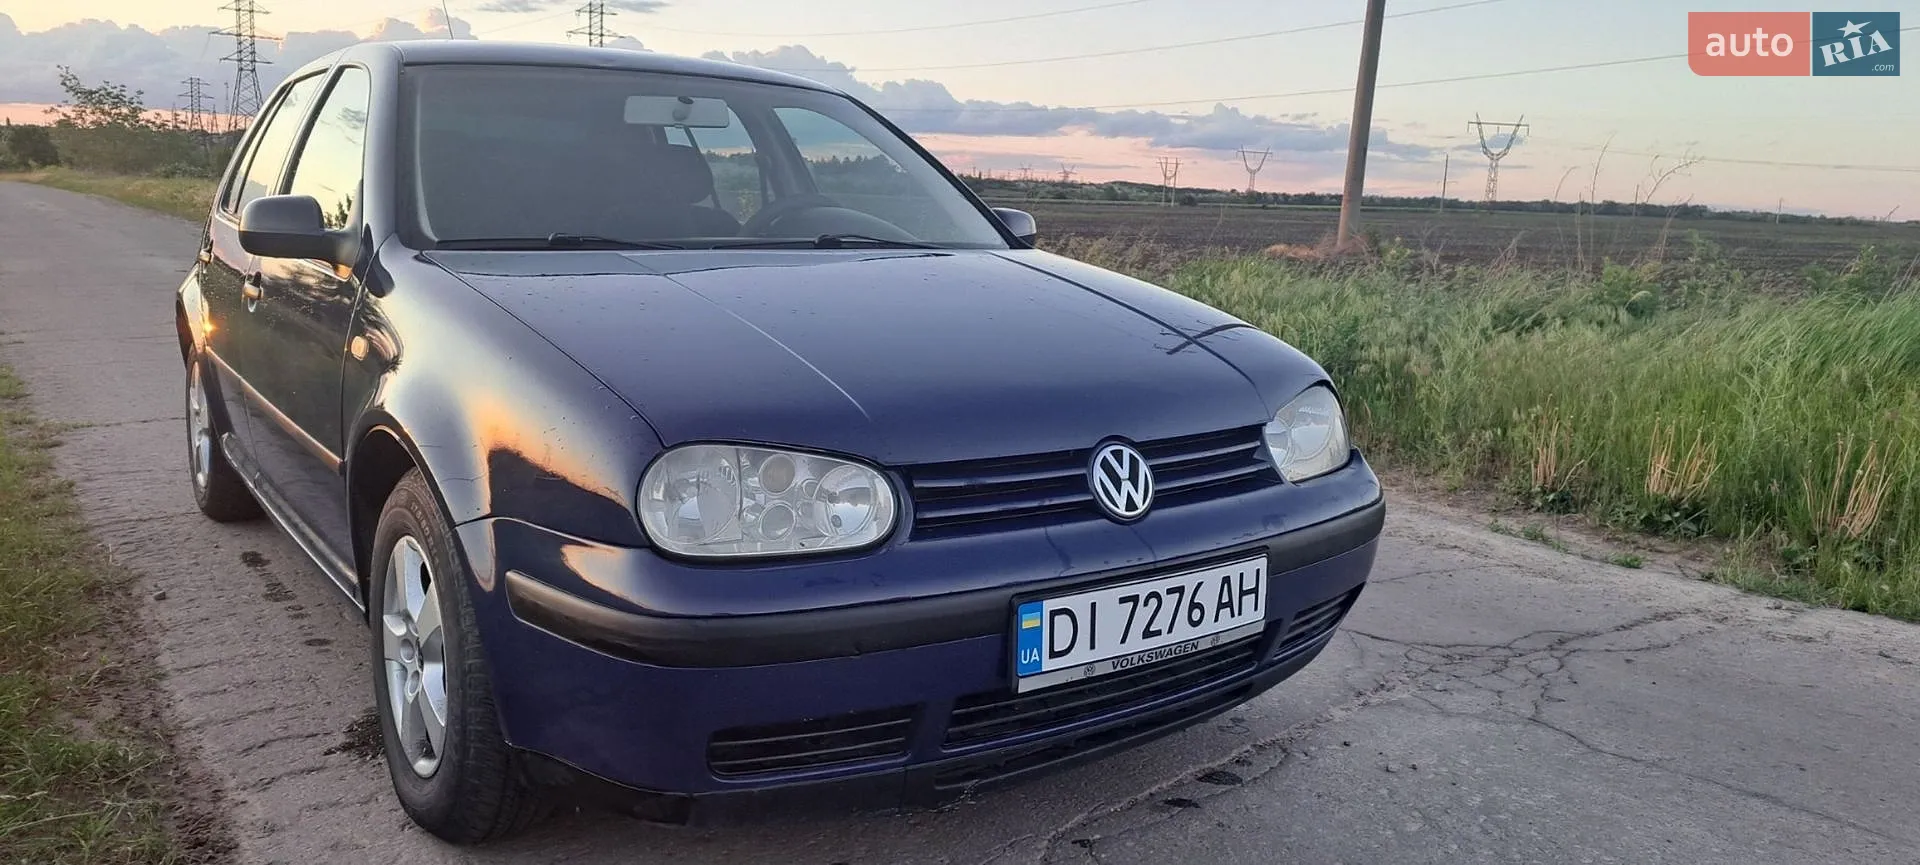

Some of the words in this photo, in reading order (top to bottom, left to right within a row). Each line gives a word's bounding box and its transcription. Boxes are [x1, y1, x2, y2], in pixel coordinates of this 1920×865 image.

[1048, 601, 1097, 660] DI
[1118, 581, 1205, 645] 7276
[1213, 567, 1260, 623] AH
[1021, 648, 1040, 664] UA
[1111, 641, 1200, 670] VOLKSWAGEN
